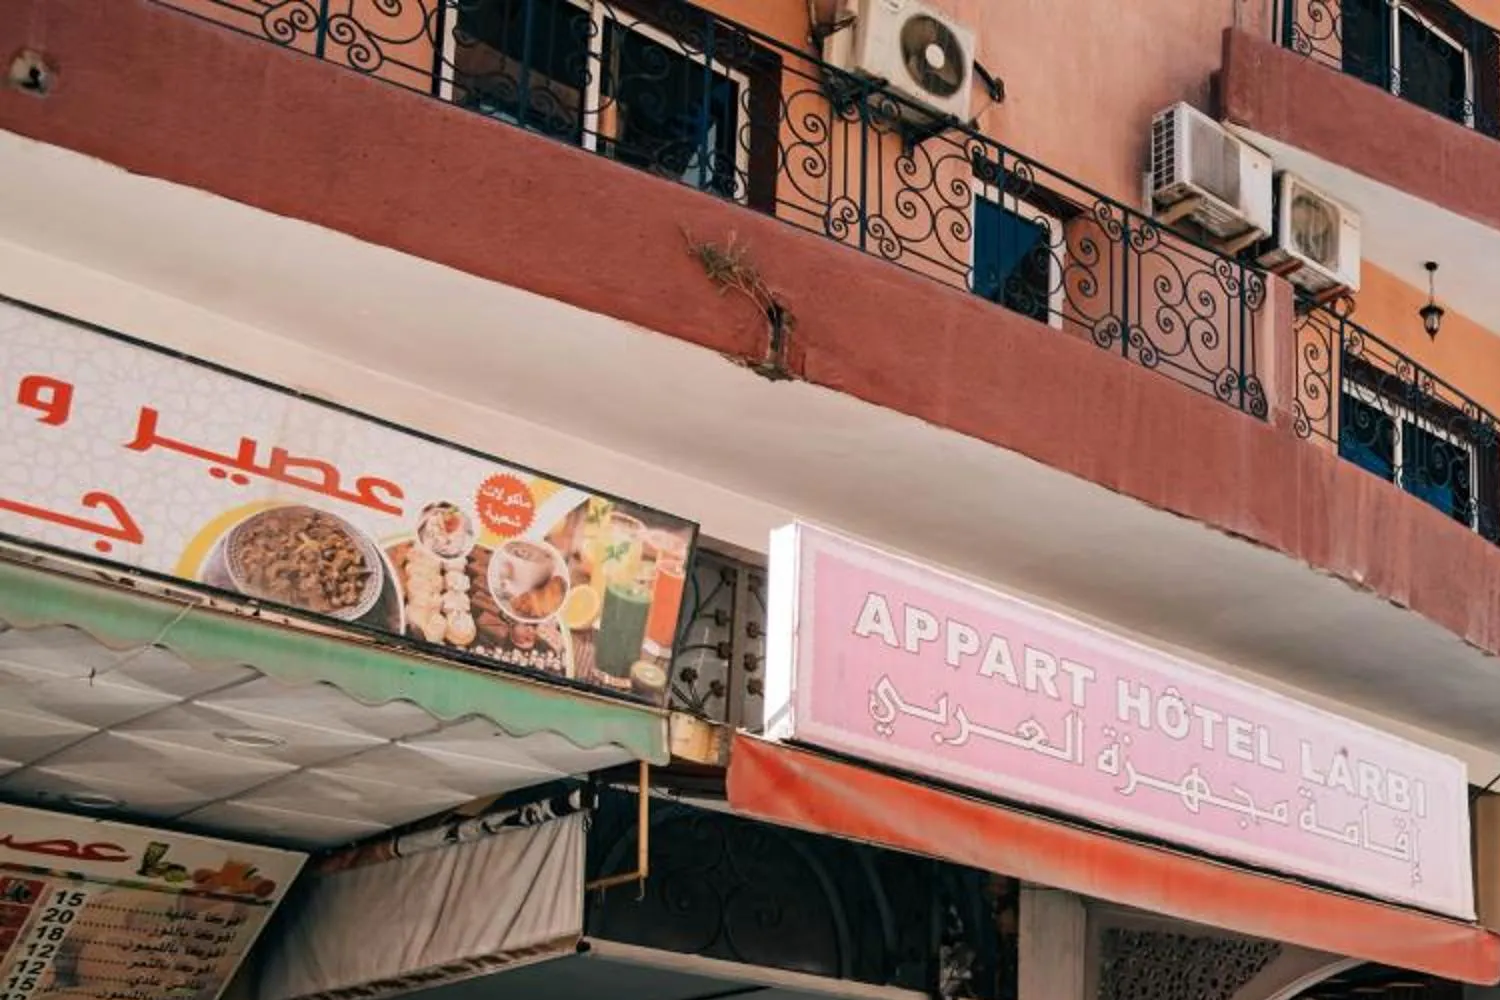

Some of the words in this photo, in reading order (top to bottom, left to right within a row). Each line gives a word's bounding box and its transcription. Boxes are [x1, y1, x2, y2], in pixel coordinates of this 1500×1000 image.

[123, 405, 405, 517] عصير
[854, 590, 1096, 709] APPART
[1116, 676, 1285, 772] HÔTEL
[1300, 740, 1429, 820] LARBI
[868, 673, 1086, 766] العربي
[1097, 724, 1290, 830] مجهزة
[55, 889, 86, 907] 15
[42, 907, 75, 926] 20
[36, 925, 64, 942] 18
[27, 941, 55, 958] 12
[16, 958, 47, 975] 12
[8, 975, 36, 992] 15
